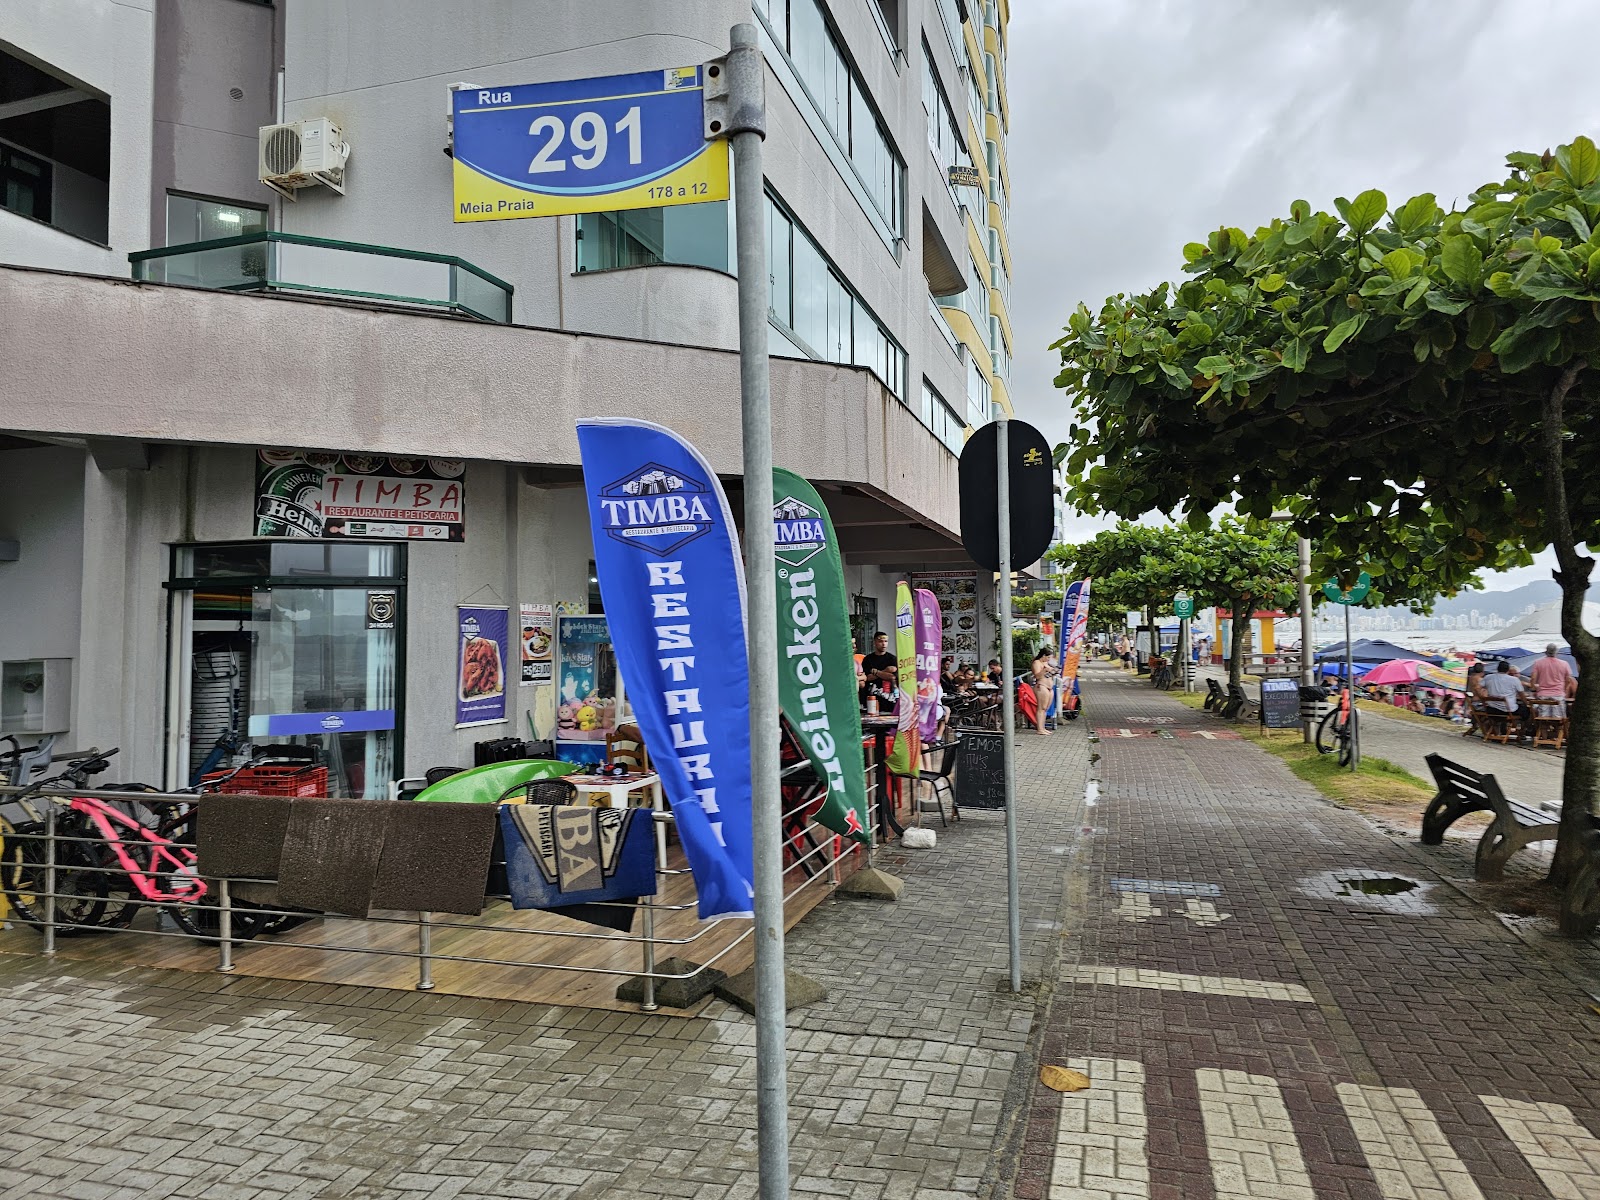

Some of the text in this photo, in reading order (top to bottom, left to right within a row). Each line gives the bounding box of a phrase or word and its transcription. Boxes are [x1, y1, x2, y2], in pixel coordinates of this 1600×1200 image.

[478, 90, 512, 105] Rua
[528, 106, 642, 174] 291
[648, 182, 708, 199] 178 a 12
[460, 198, 535, 214] Meia Praia
[281, 472, 322, 493] HEINEKEN
[326, 477, 461, 509] TIMBA
[329, 506, 455, 521] RESTAURANTE E PETISCARIA
[601, 496, 712, 526] TIMBA
[774, 521, 826, 543] IMBA
[961, 736, 1002, 752] TEMOS
